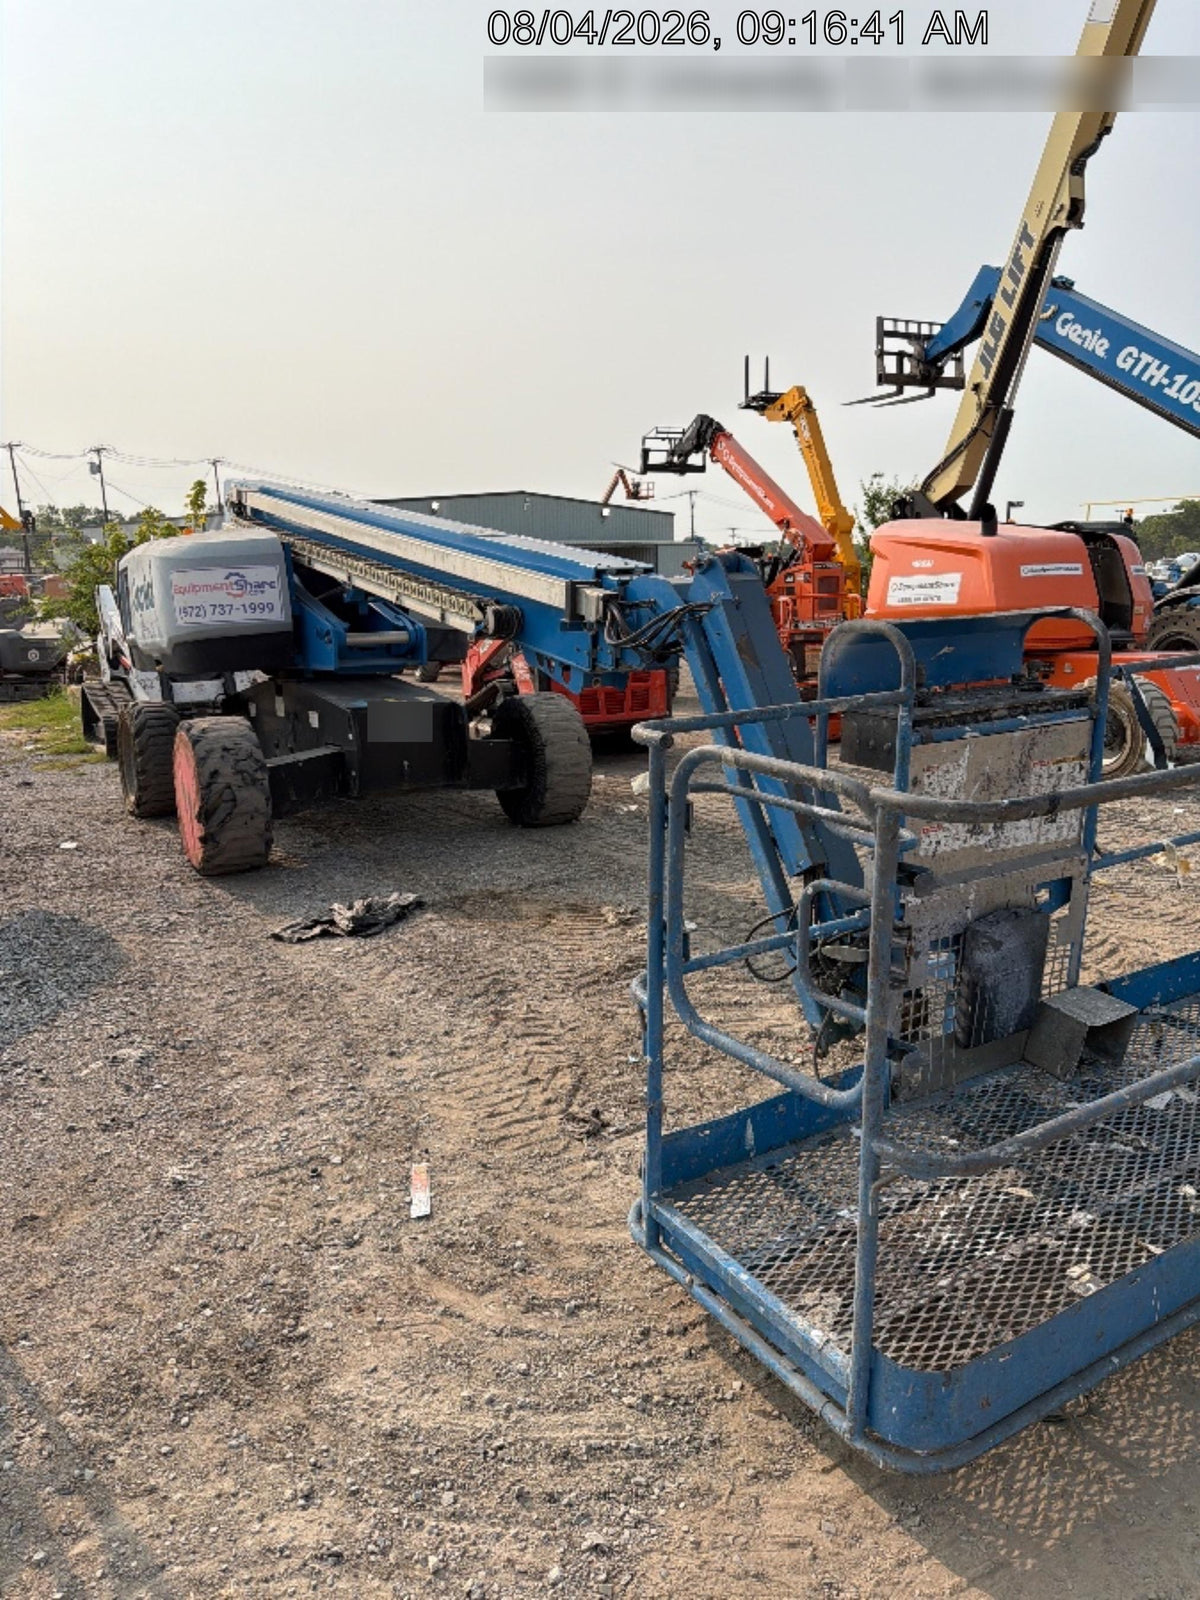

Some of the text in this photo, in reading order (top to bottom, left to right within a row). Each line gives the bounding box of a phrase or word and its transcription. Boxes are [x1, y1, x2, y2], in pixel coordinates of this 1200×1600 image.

[978, 220, 1036, 380] JLG LIFT
[1055, 312, 1110, 358] Genie
[209, 602, 275, 616] 737-1999
